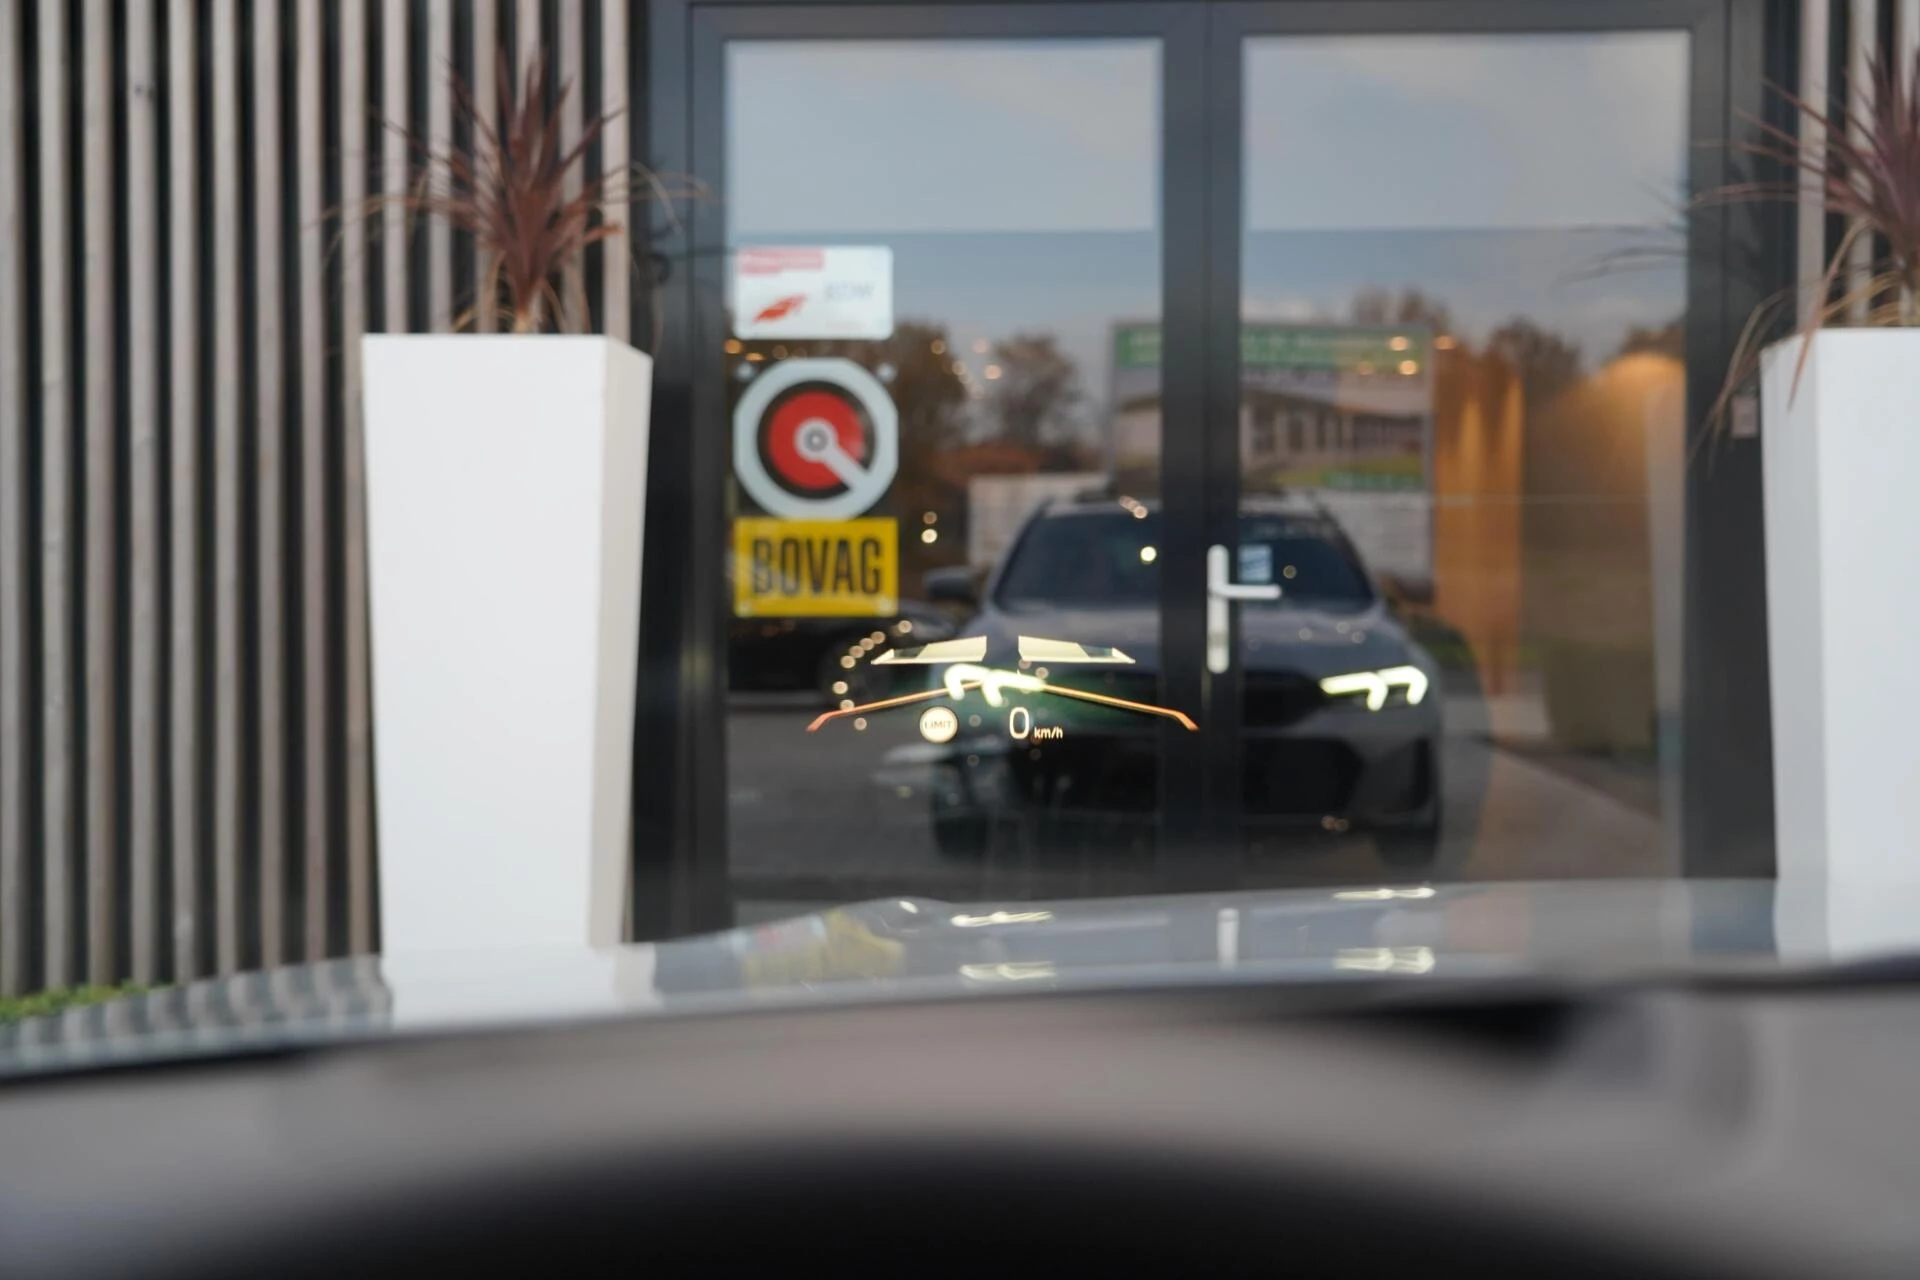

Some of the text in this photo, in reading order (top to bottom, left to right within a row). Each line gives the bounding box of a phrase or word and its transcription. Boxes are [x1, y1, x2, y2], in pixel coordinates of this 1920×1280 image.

[753, 537, 881, 595] BOVAG
[924, 720, 952, 730] LIMIT
[1009, 706, 1063, 739] 0 km/h
